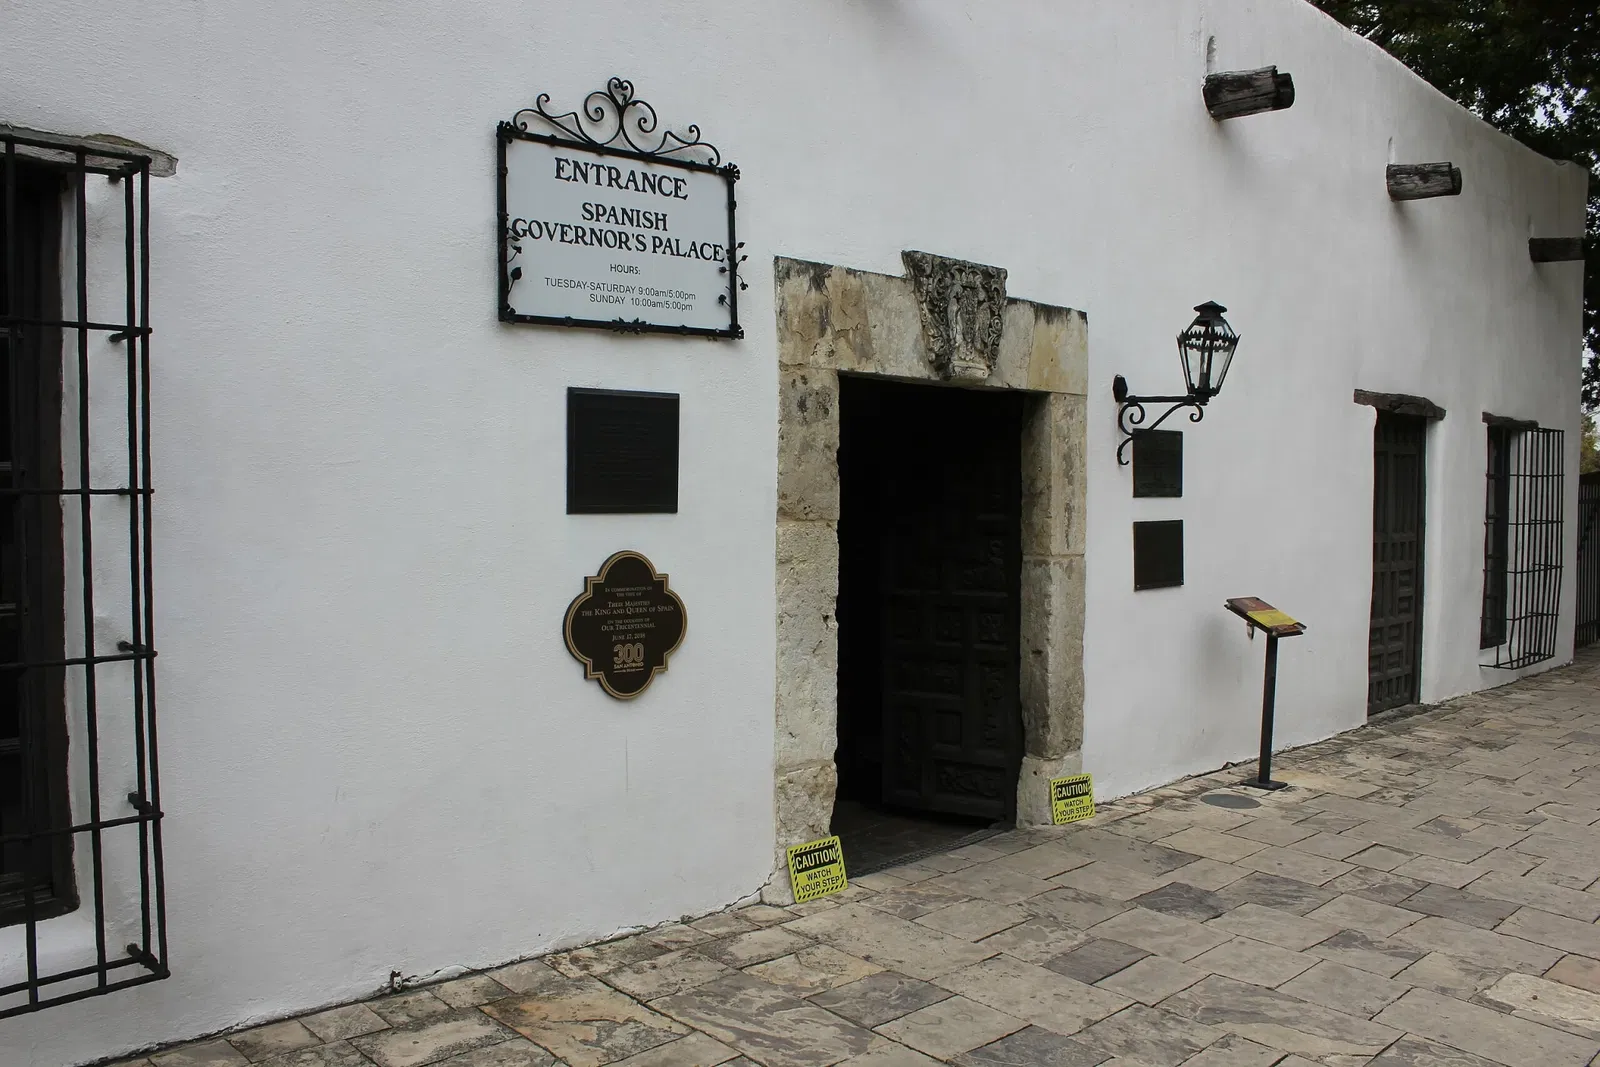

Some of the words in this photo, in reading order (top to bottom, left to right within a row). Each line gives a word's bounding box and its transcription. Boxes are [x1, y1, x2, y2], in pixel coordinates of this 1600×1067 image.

[554, 157, 688, 200] ENTRANCE
[582, 202, 668, 231] SPANISH
[512, 218, 647, 252] GOVERNOR'S
[652, 236, 724, 262] PALACE
[610, 264, 641, 275] HOURS:
[544, 278, 636, 294] TUESDAY-SATURDAY
[638, 286, 696, 300] 9:00am/5:00pm
[589, 294, 626, 305] SUNDAY
[630, 298, 692, 311] 10:00am/5:00pm
[615, 622, 656, 630] TRICENTENNIAL
[613, 642, 644, 664] 300
[1057, 783, 1089, 798] CAUTION
[1064, 799, 1083, 808] WATCH
[795, 848, 836, 870] CAUTION
[806, 868, 831, 882] WATCH
[801, 882, 821, 894] YOUR
[822, 876, 840, 887] STEP
